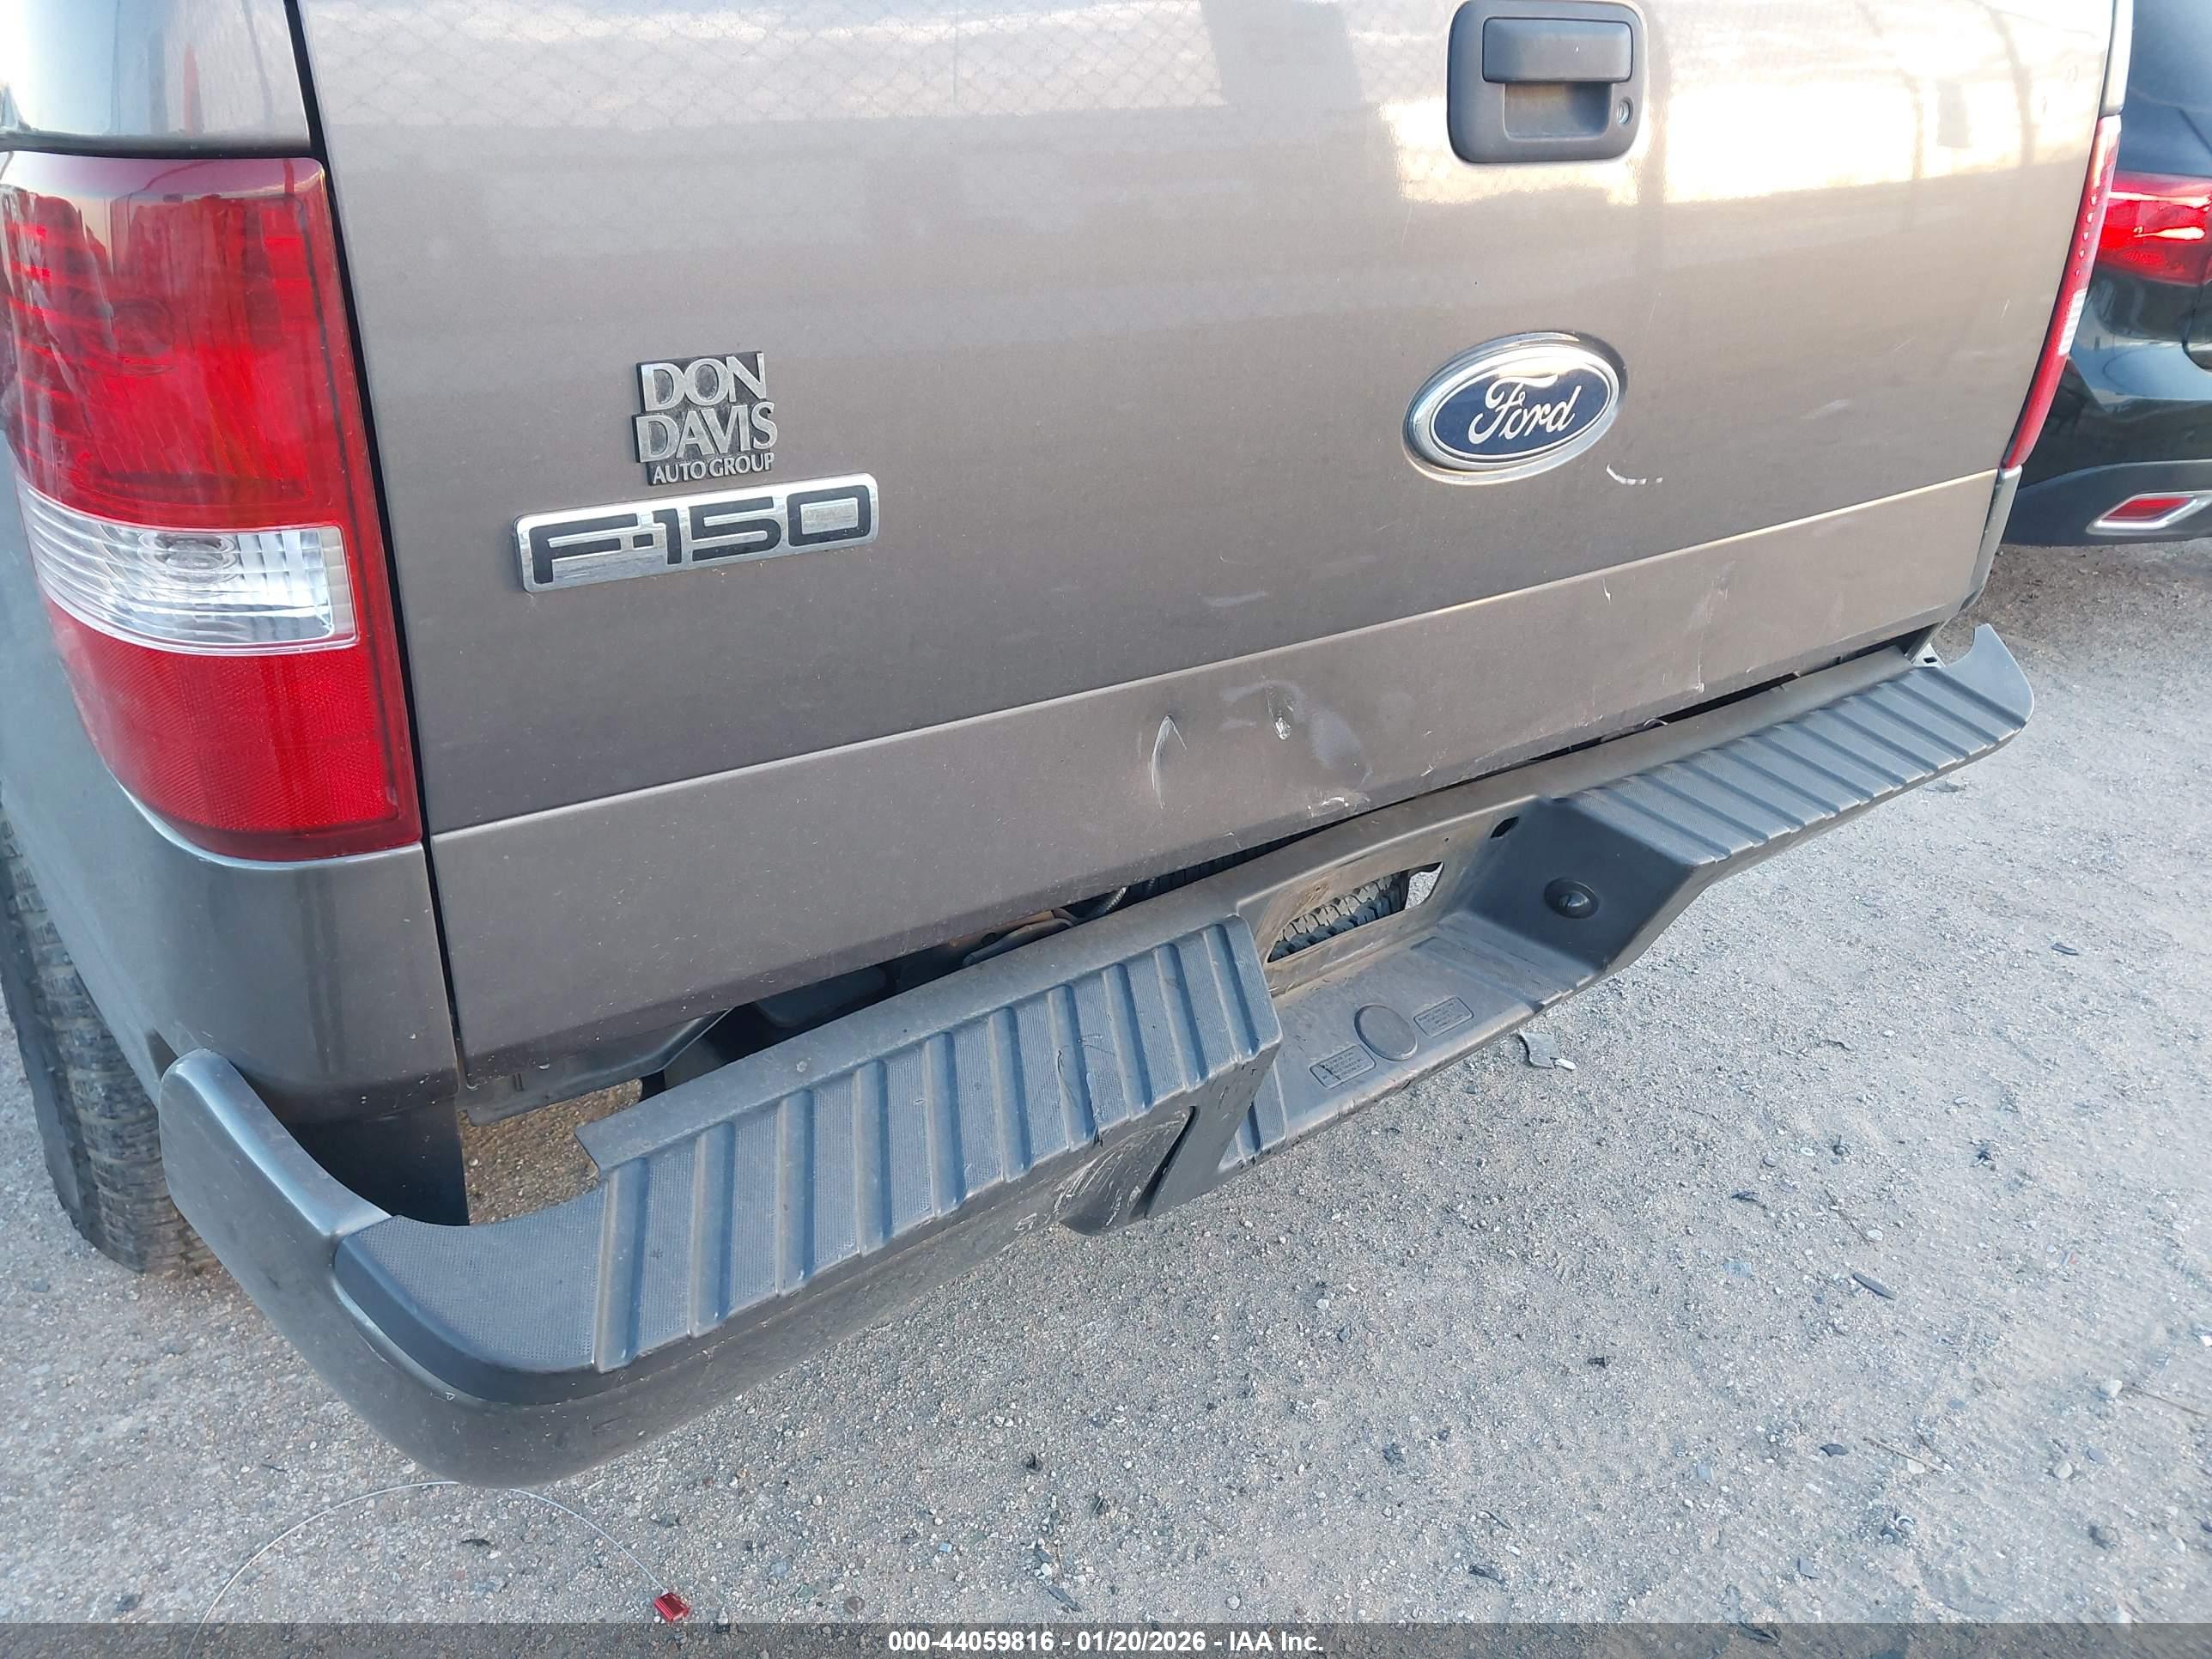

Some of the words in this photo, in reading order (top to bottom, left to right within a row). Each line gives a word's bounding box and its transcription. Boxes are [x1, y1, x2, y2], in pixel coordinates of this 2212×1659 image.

[641, 352, 767, 411] DON
[1468, 374, 1582, 445] Ford
[634, 401, 778, 463] DAVIS
[653, 459, 706, 484] AUTO
[708, 452, 775, 477] GROUP
